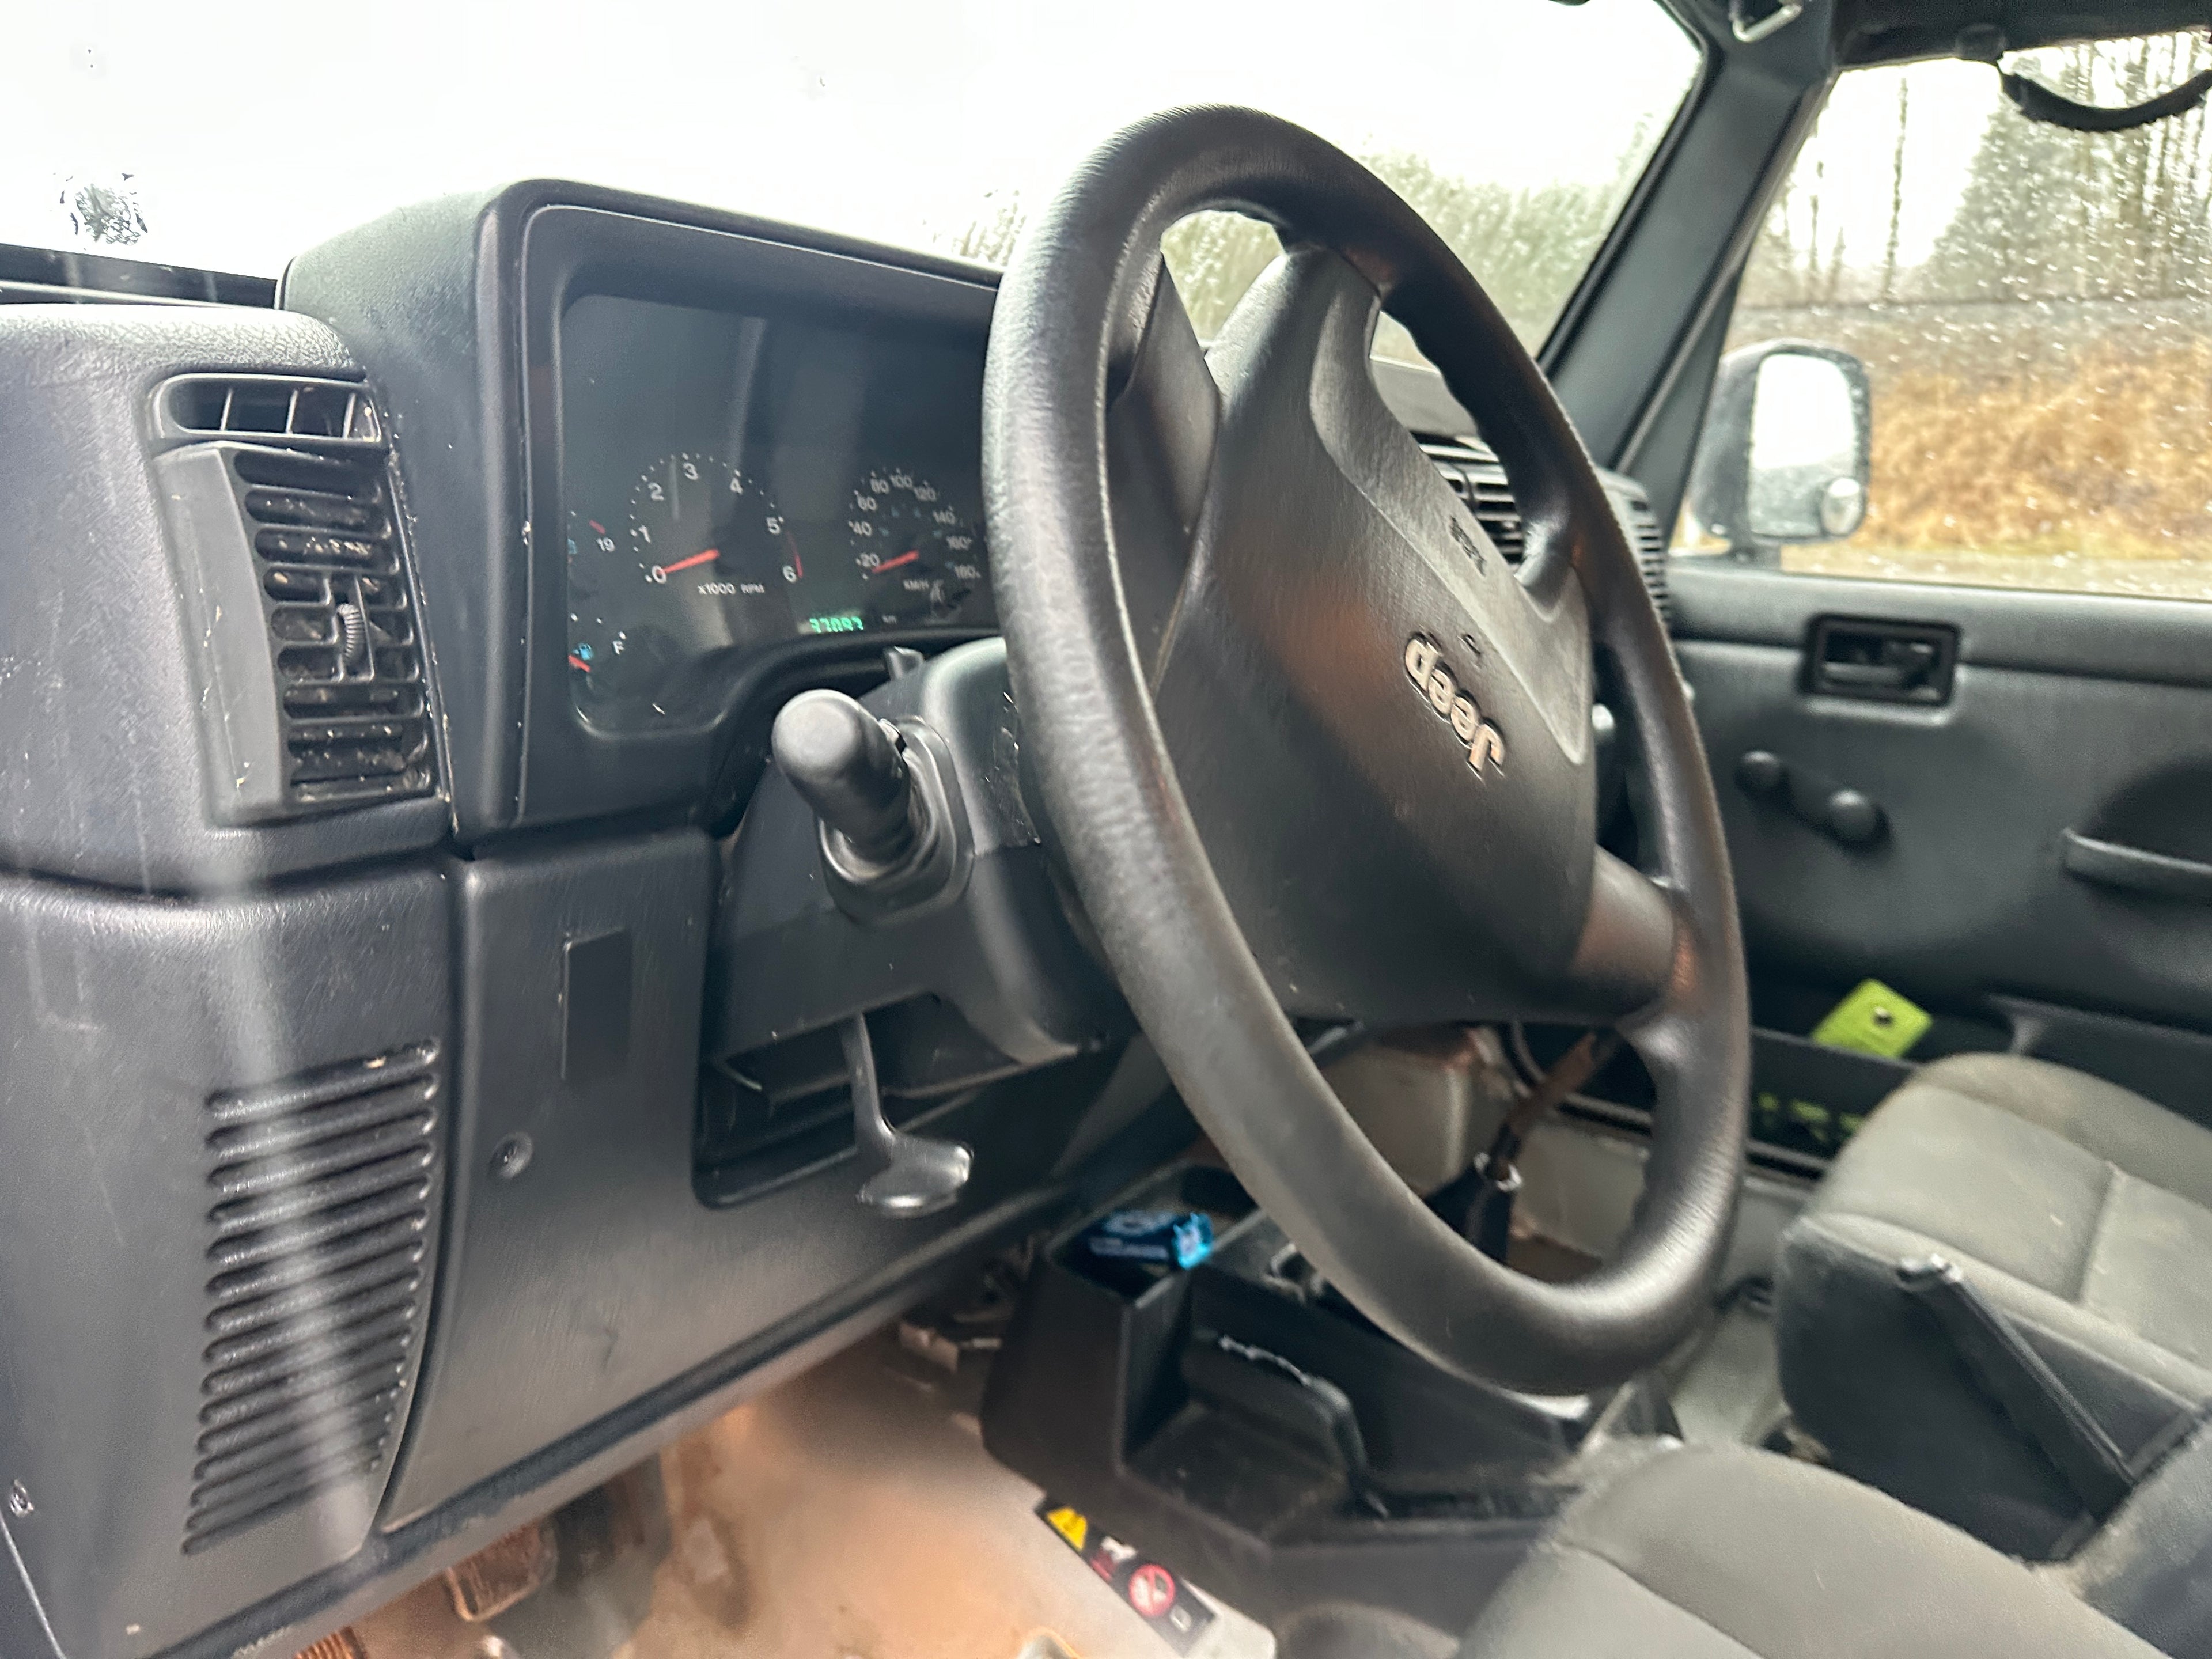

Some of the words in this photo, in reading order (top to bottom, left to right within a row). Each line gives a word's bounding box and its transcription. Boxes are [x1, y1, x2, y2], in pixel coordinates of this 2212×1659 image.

[683, 462, 699, 480] 3
[730, 478, 743, 494] 4
[890, 474, 914, 488] 100
[648, 482, 665, 501] 2
[638, 525, 651, 543] 1
[766, 517, 781, 535] 5
[651, 565, 667, 584] 0
[782, 565, 797, 583] 6
[1404, 635, 1506, 775] Jeep
